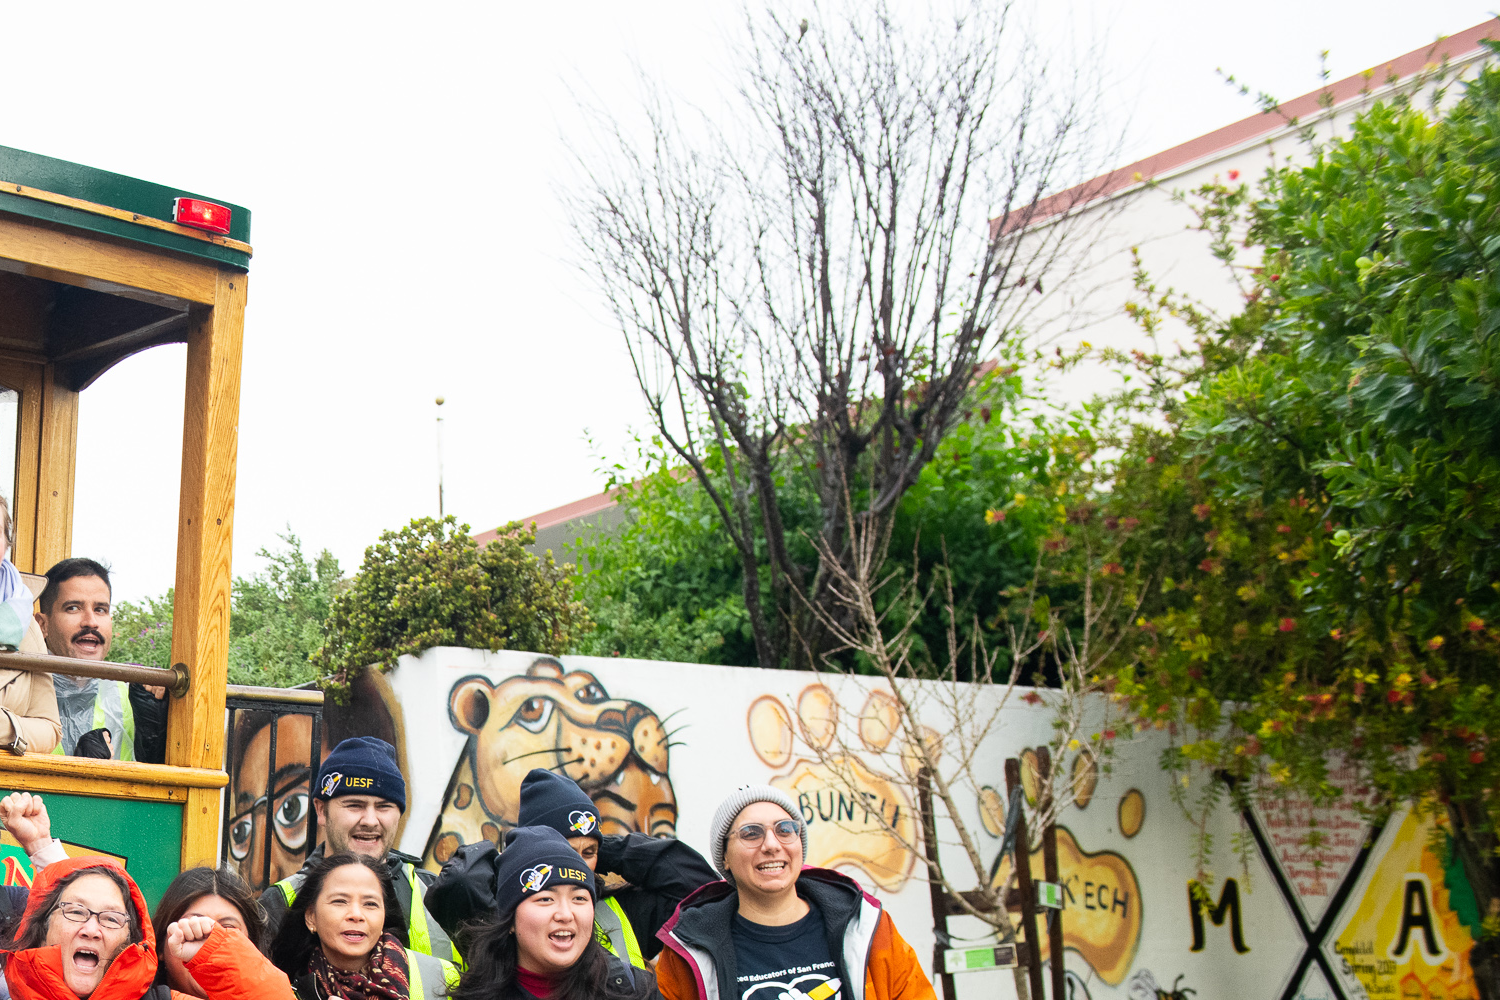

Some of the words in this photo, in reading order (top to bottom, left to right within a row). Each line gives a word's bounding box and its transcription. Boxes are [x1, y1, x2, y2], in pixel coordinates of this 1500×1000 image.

[345, 777, 373, 788] UESF
[559, 867, 587, 882] UESF
[1188, 877, 1251, 954] M
[1391, 879, 1443, 957] A
[749, 969, 787, 981] Educators
[787, 966, 797, 975] of
[797, 965, 812, 973] San
